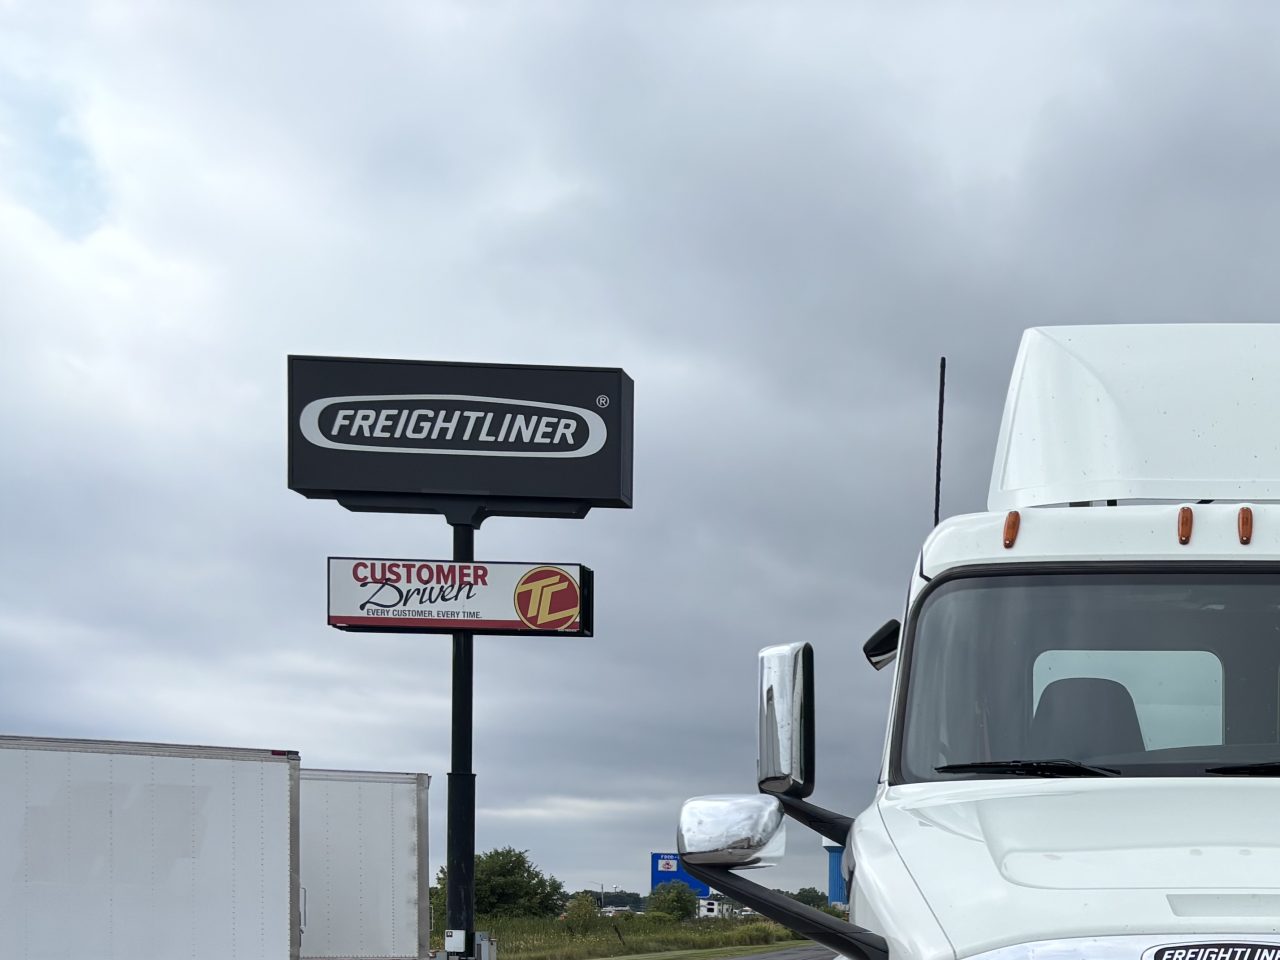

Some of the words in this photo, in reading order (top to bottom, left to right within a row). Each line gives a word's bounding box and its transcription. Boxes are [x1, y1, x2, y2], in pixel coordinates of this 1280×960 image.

[331, 409, 577, 444] FREIGHTLINER
[352, 561, 489, 585] CUSTOMER
[360, 578, 476, 611] Driven
[517, 575, 579, 624] TC
[367, 608, 390, 617] EVERY
[392, 609, 435, 618] CUSTOMER.
[437, 611, 460, 619] EVERY
